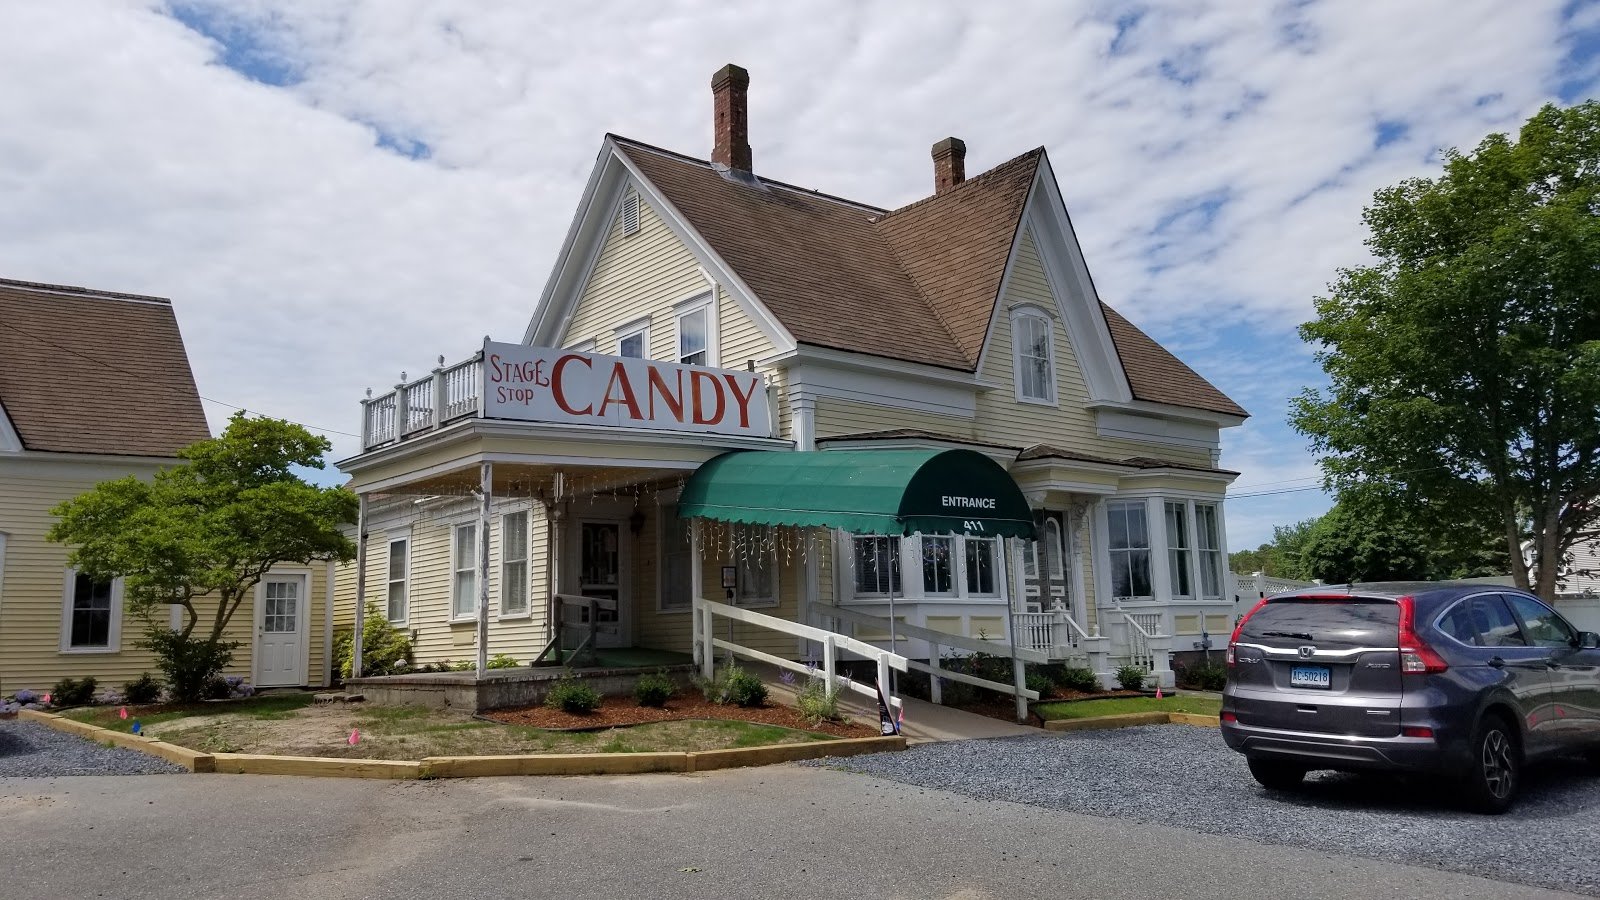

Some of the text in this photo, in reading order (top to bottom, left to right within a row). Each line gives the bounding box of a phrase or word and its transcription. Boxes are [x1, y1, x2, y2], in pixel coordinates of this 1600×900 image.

[490, 354, 550, 387] STAGE
[496, 386, 534, 406] STOP
[551, 354, 758, 428] CANDY
[941, 495, 996, 509] ENTRANCE
[963, 520, 985, 532] 411
